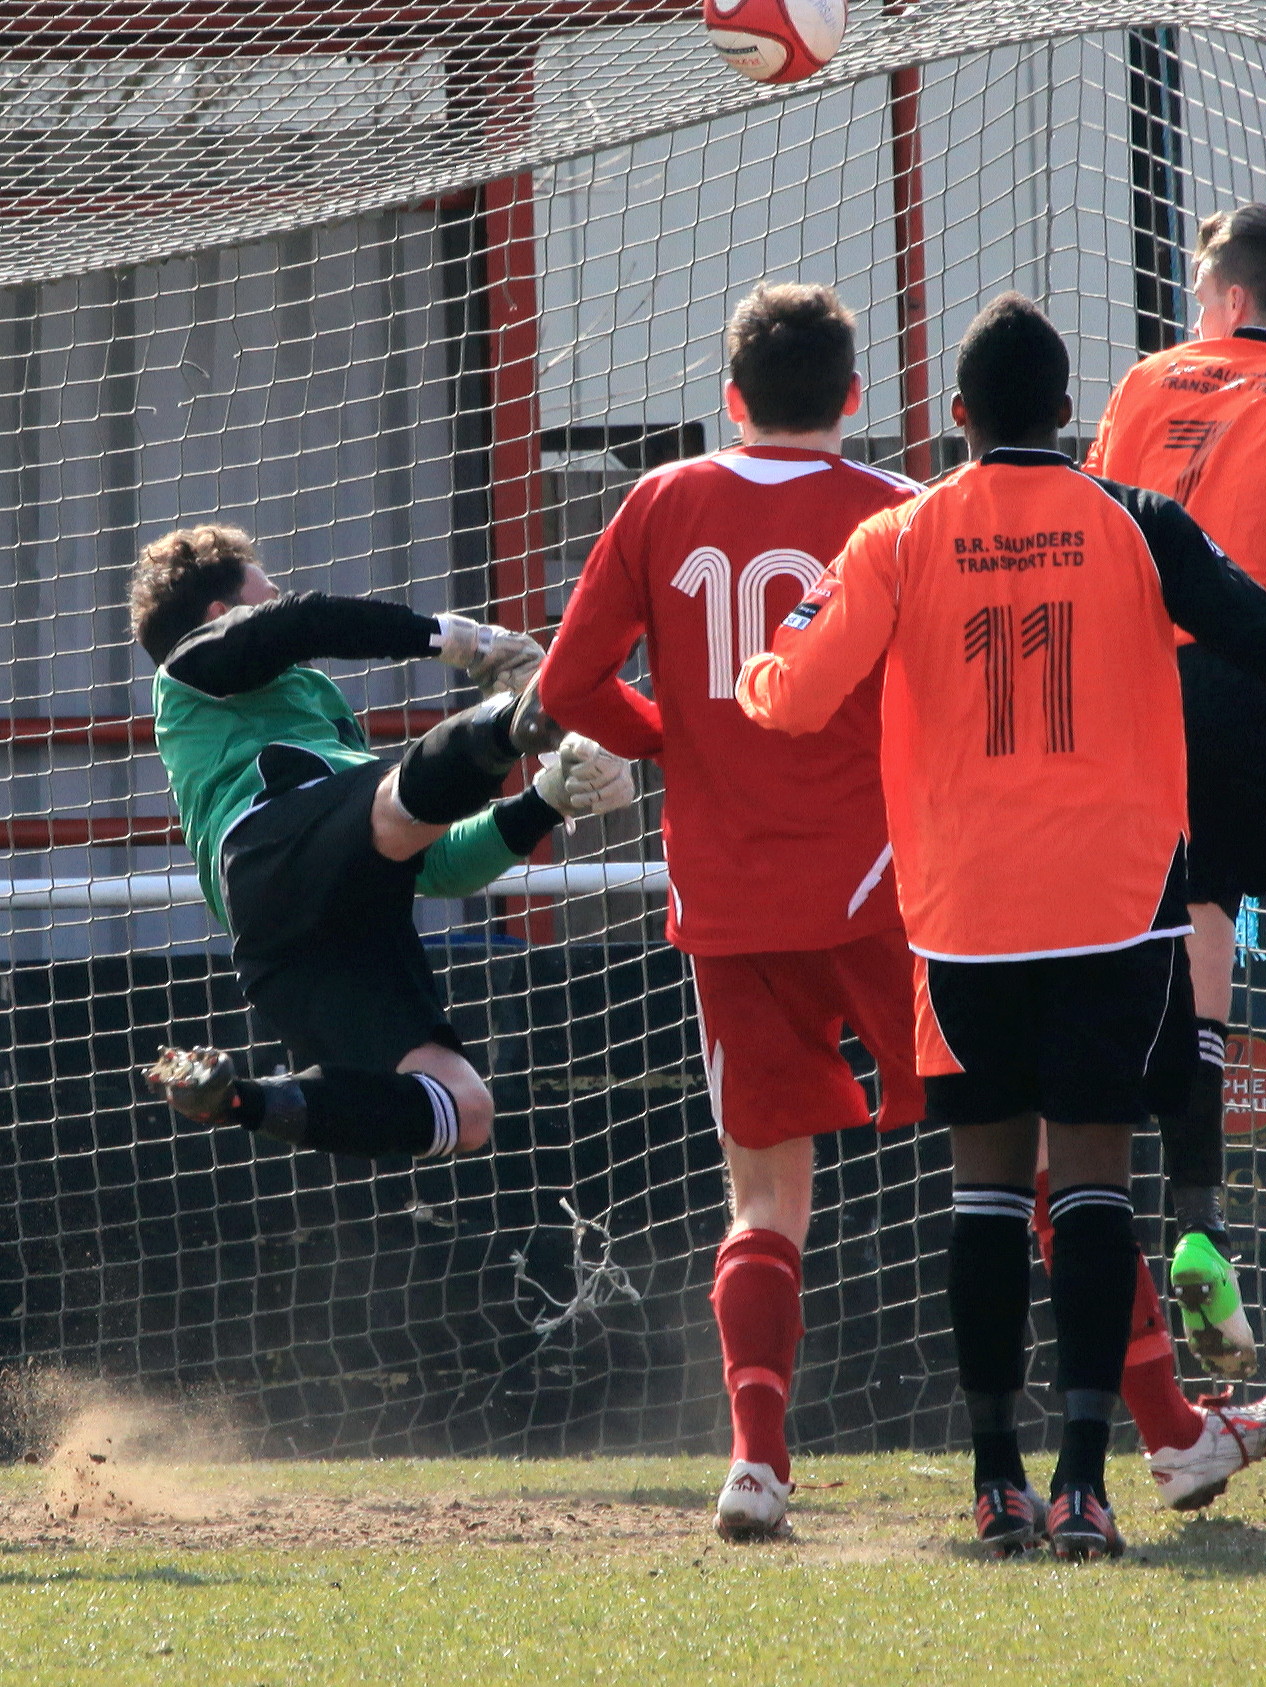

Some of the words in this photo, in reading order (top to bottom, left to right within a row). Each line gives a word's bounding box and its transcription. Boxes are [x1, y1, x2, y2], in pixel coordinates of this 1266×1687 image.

[1161, 376, 1243, 394] TRANSP
[1164, 419, 1234, 507] 7
[954, 538, 990, 554] B.R.
[993, 530, 1085, 552] SAUNDERS
[956, 553, 1047, 574] TRANSPORT
[1052, 551, 1084, 567] LTD
[670, 546, 827, 699] 10
[964, 601, 1075, 757] 11
